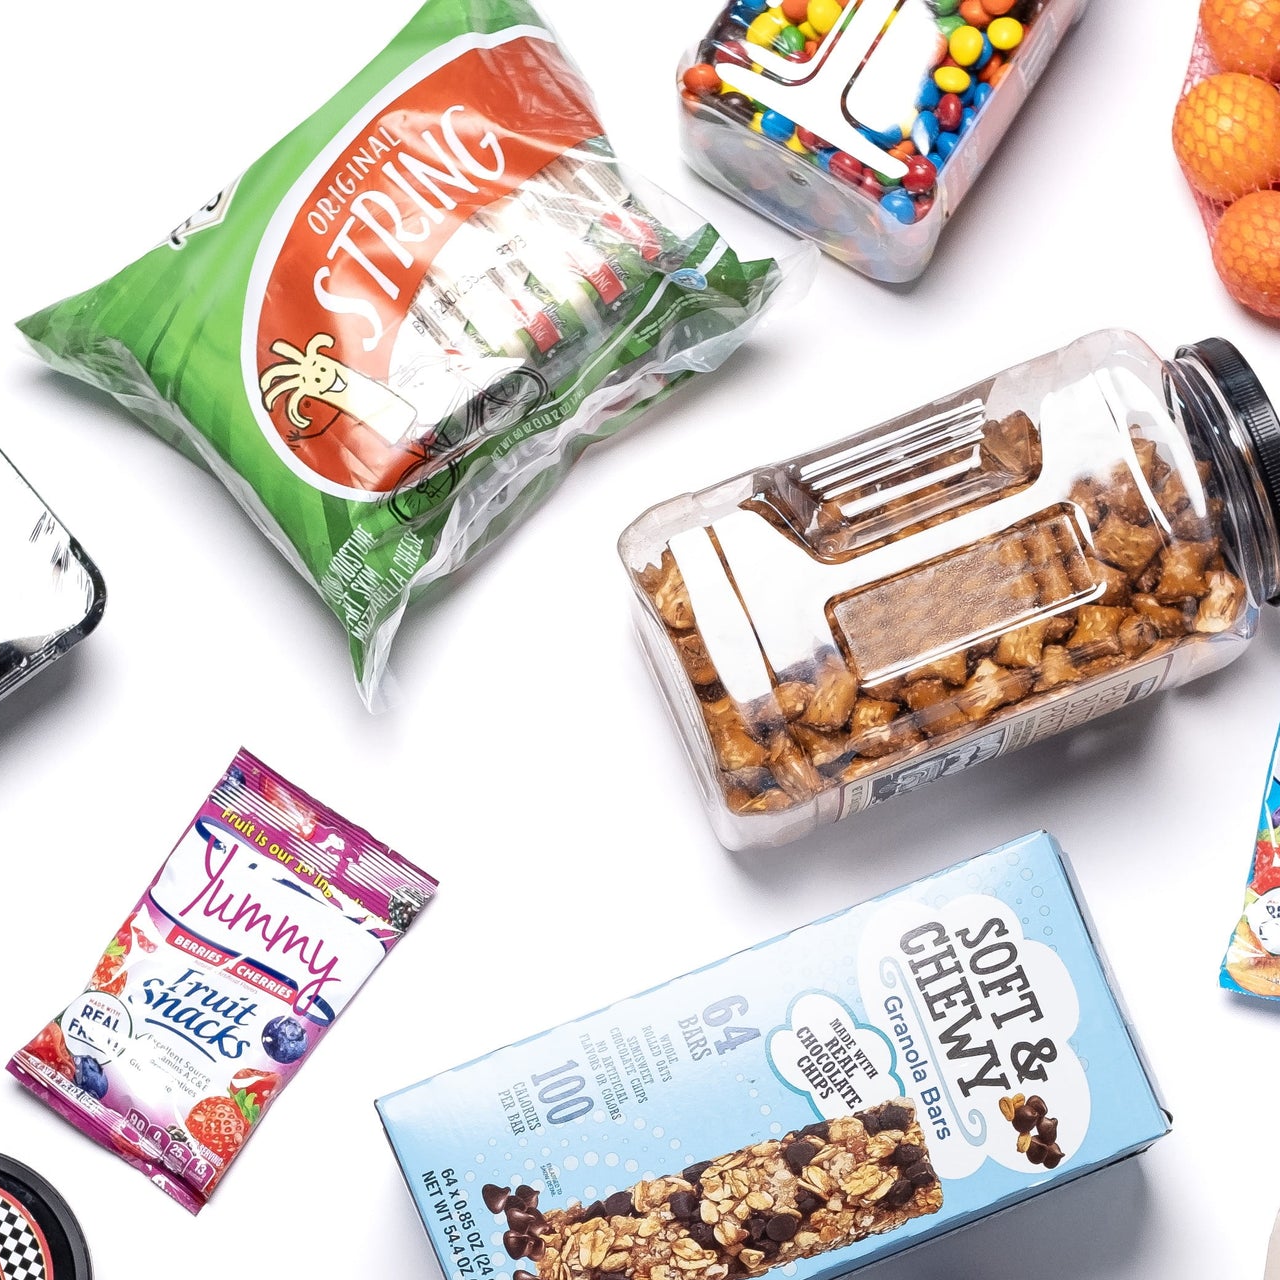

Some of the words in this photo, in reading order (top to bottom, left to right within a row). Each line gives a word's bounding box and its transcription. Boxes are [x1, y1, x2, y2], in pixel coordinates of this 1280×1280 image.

[307, 125, 402, 236] ORIGINAL
[313, 104, 505, 351] STRING
[392, 530, 423, 573] CHEESE
[255, 832, 267, 846] is
[179, 834, 342, 1015] Yummy
[174, 935, 221, 962] BERRIES
[236, 965, 292, 998] CHERRIES
[702, 995, 760, 1054] 64
[903, 923, 1009, 1095] CHEWY
[956, 918, 1041, 1027] SOFT
[1007, 1034, 1061, 1086] &
[627, 1036, 654, 1084] SEMISWEET
[678, 1015, 711, 1061] BARS
[824, 1036, 857, 1078] REAL
[829, 1018, 856, 1049] MADE
[853, 1049, 878, 1078] WITH
[602, 1056, 628, 1104] ARTIFICIAL
[630, 1077, 648, 1103] CHIPS
[655, 1059, 672, 1082] OATS
[797, 1027, 861, 1108] CHOCOLATE
[797, 1055, 833, 1098] CHIPS
[884, 996, 927, 1082] Granola
[920, 1086, 950, 1139] Bars
[498, 1089, 515, 1111] PER
[507, 1113, 525, 1135] BAR
[514, 1082, 541, 1130] CALORIES
[532, 1060, 593, 1124] 100
[601, 1088, 621, 1120] COLORS
[441, 1168, 457, 1186] 64
[422, 1170, 442, 1196] NET
[434, 1199, 452, 1221] WT
[443, 1224, 464, 1254] 54.4
[456, 1256, 473, 1276] OZ
[454, 1200, 475, 1229] 0.85
[466, 1231, 481, 1250] OZ
[472, 1253, 493, 1275] (24
